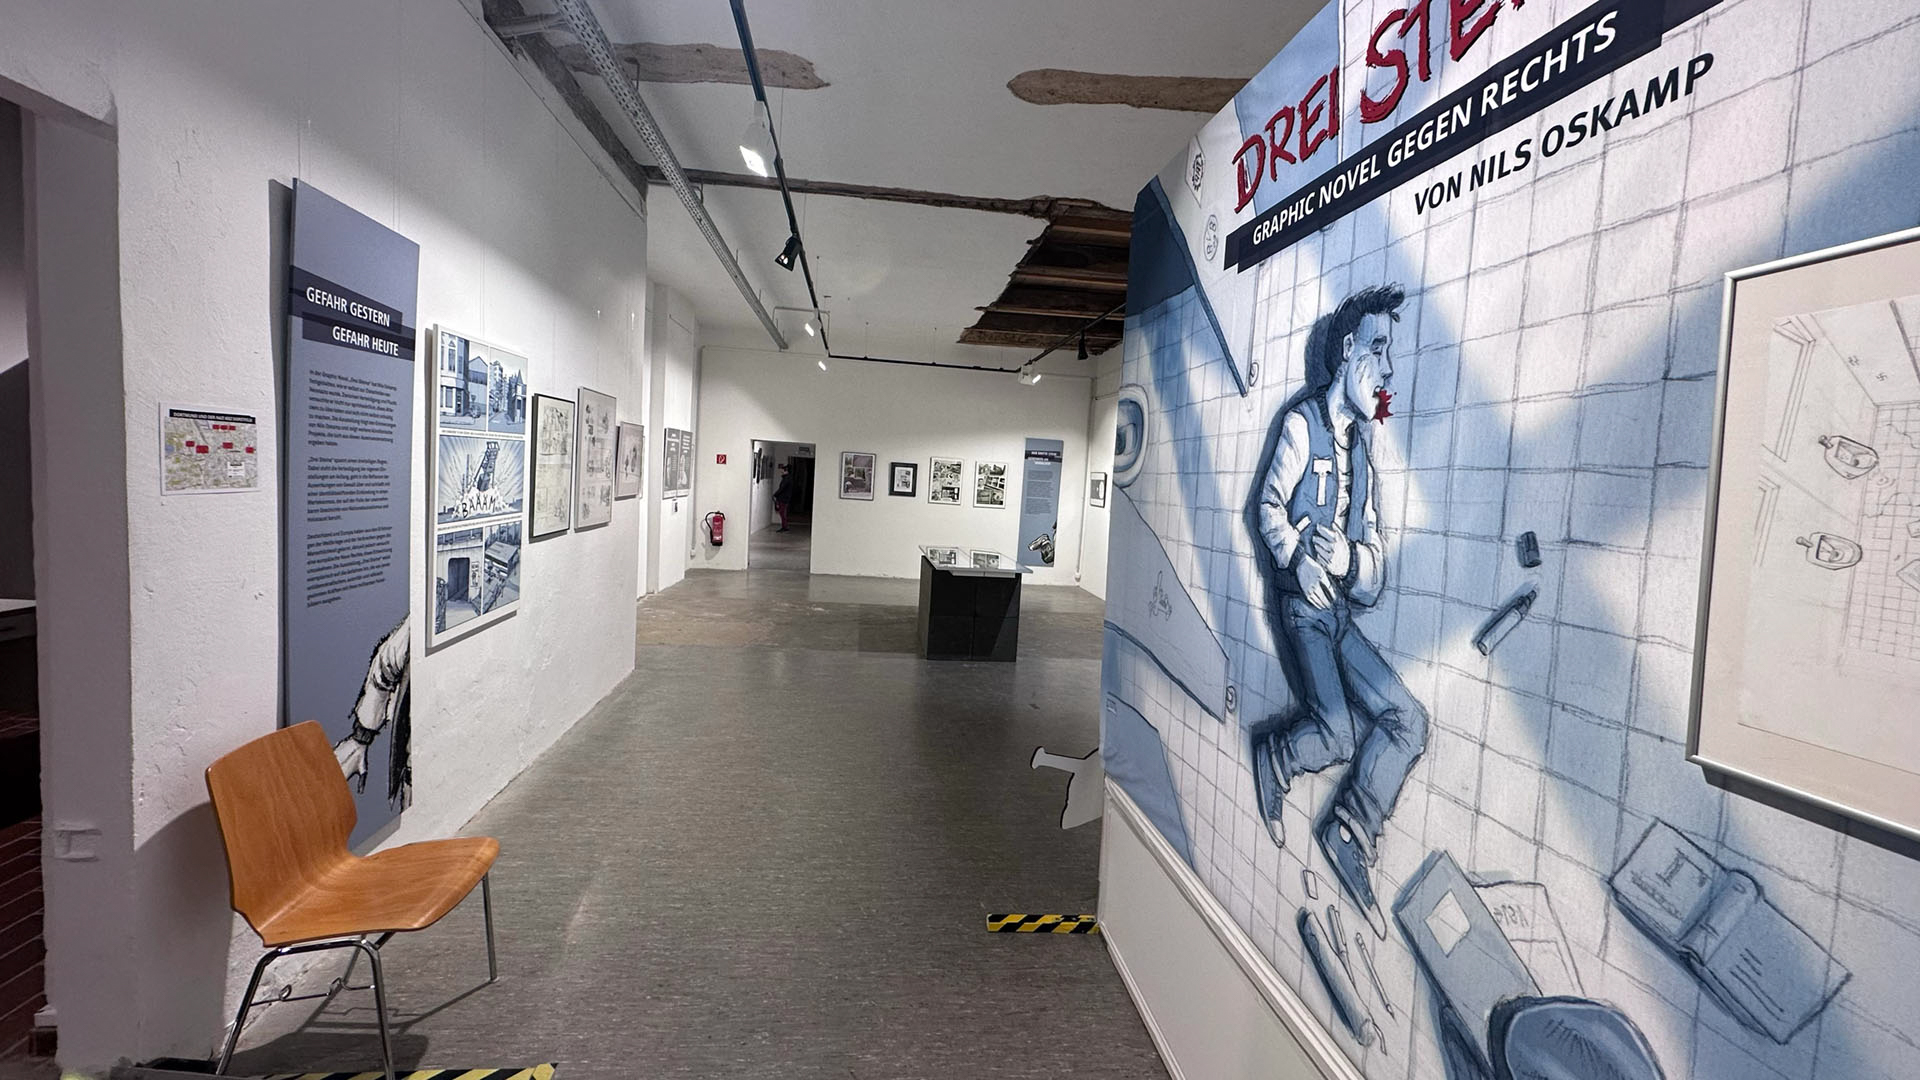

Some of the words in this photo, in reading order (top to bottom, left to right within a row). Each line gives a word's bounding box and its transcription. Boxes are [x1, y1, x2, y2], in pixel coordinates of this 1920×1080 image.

[1233, 65, 1340, 213] DREI
[1360, 0, 1524, 123] STE
[1252, 196, 1315, 246] GRAPHIC
[1319, 156, 1381, 208] NOVEL
[1386, 105, 1472, 168] GEGEN
[1481, 11, 1618, 115] RECHTS
[1414, 171, 1462, 215] VON
[1469, 138, 1531, 193] NILS
[1541, 53, 1714, 158] OSKAMP
[306, 286, 348, 314] GEFAHR
[349, 302, 391, 328] GESTERN
[332, 325, 370, 349] GEFAHR
[371, 337, 399, 357] HEUTE
